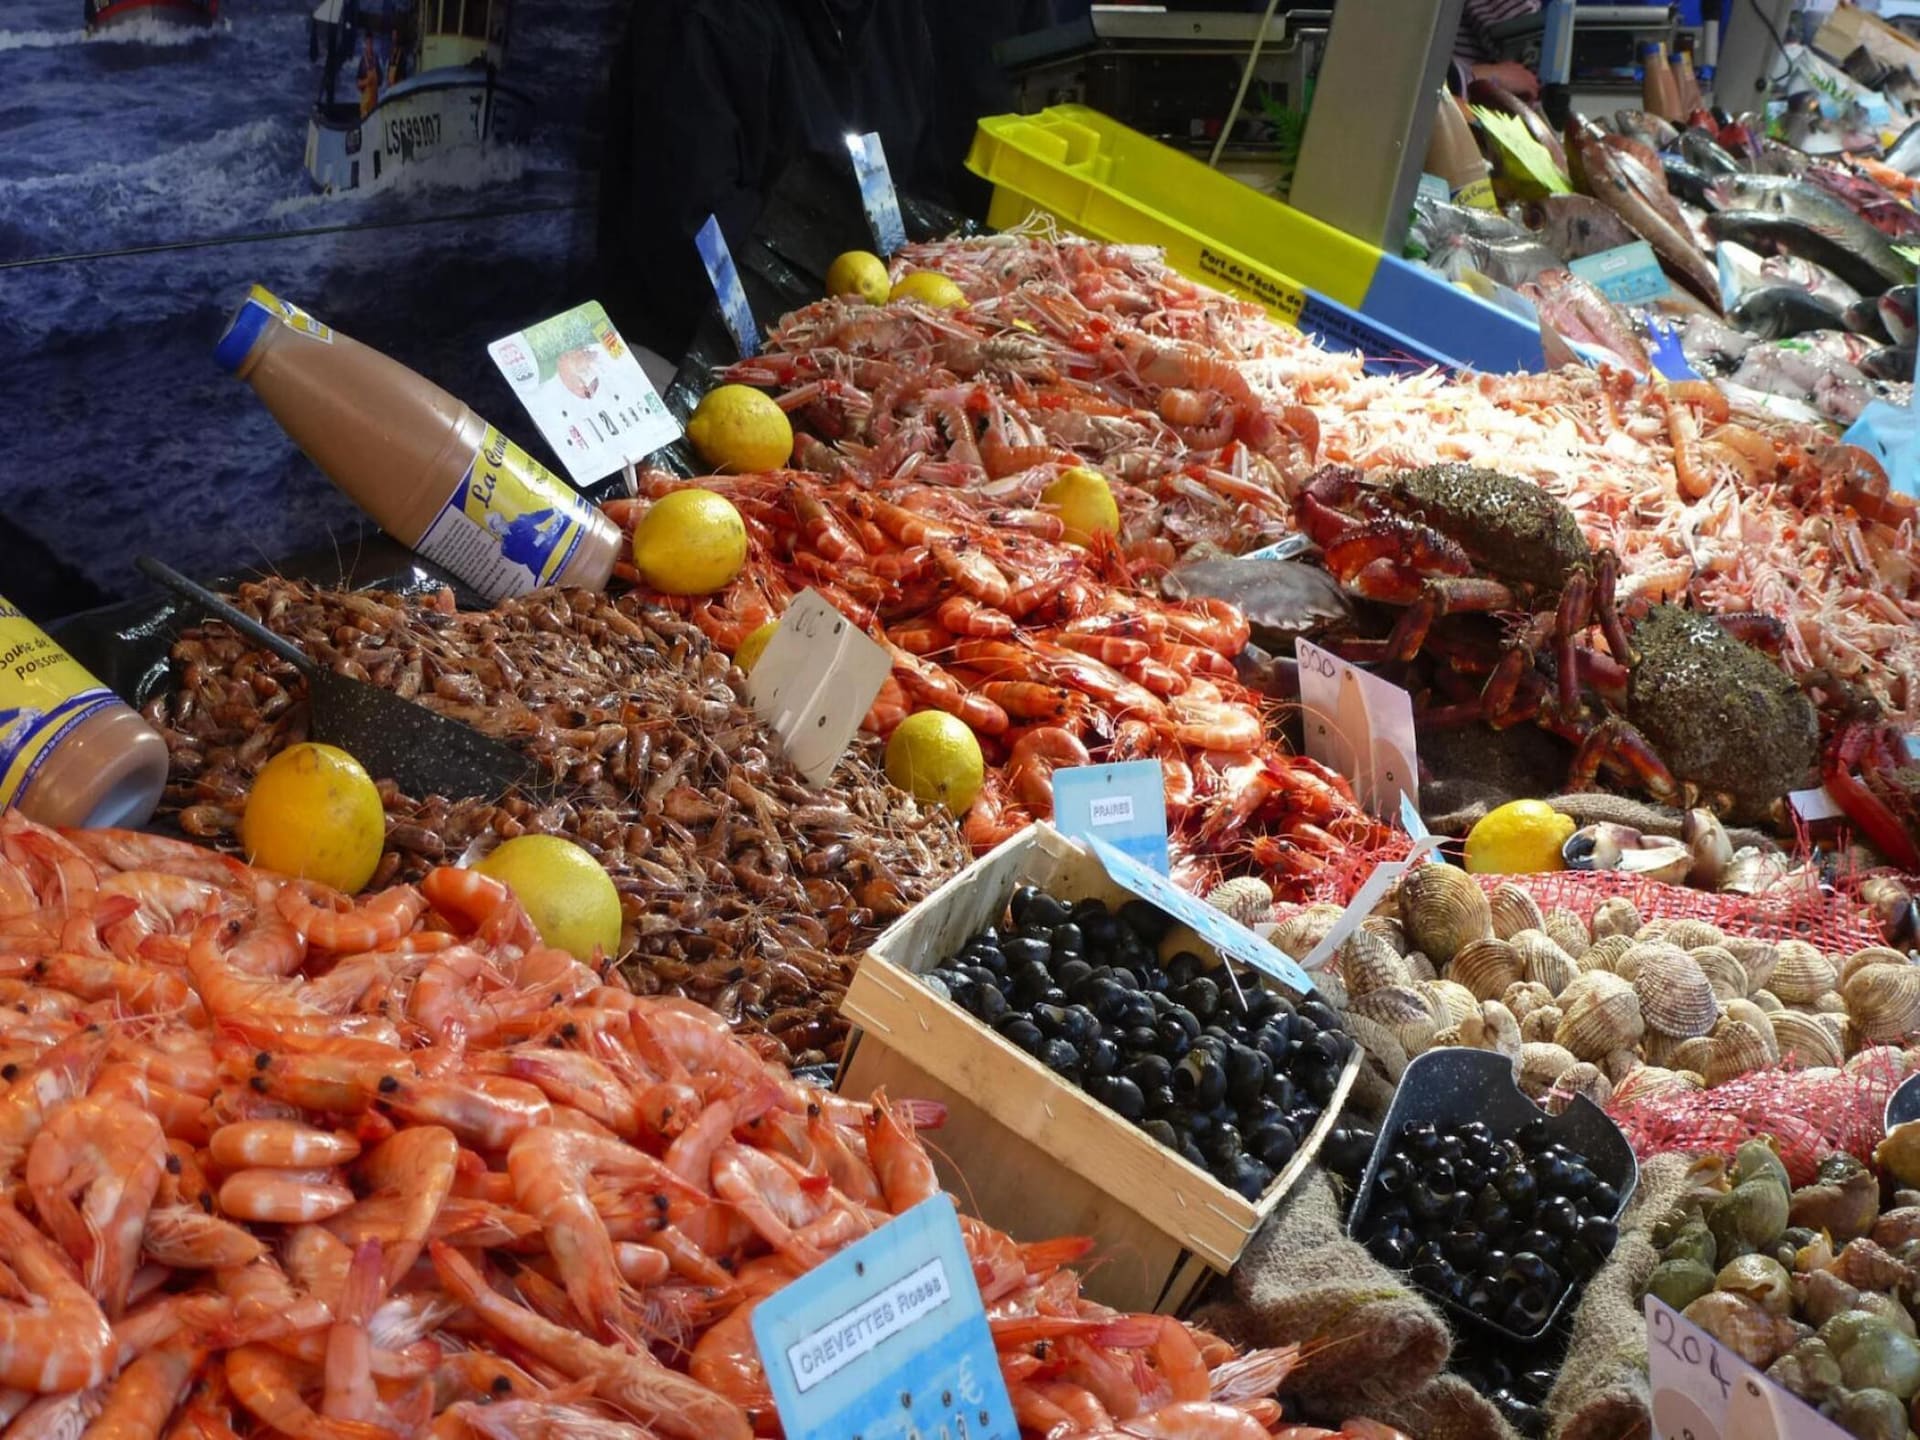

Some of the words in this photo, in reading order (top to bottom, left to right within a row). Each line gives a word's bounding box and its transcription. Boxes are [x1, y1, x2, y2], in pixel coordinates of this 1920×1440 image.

[1201, 249, 1226, 268] Port
[1229, 265, 1243, 278] de
[1286, 294, 1302, 307] de
[472, 472, 497, 509] La
[1093, 800, 1130, 818] PRAIRES
[801, 1303, 895, 1375] CREVETTES
[896, 1276, 942, 1316] Roses
